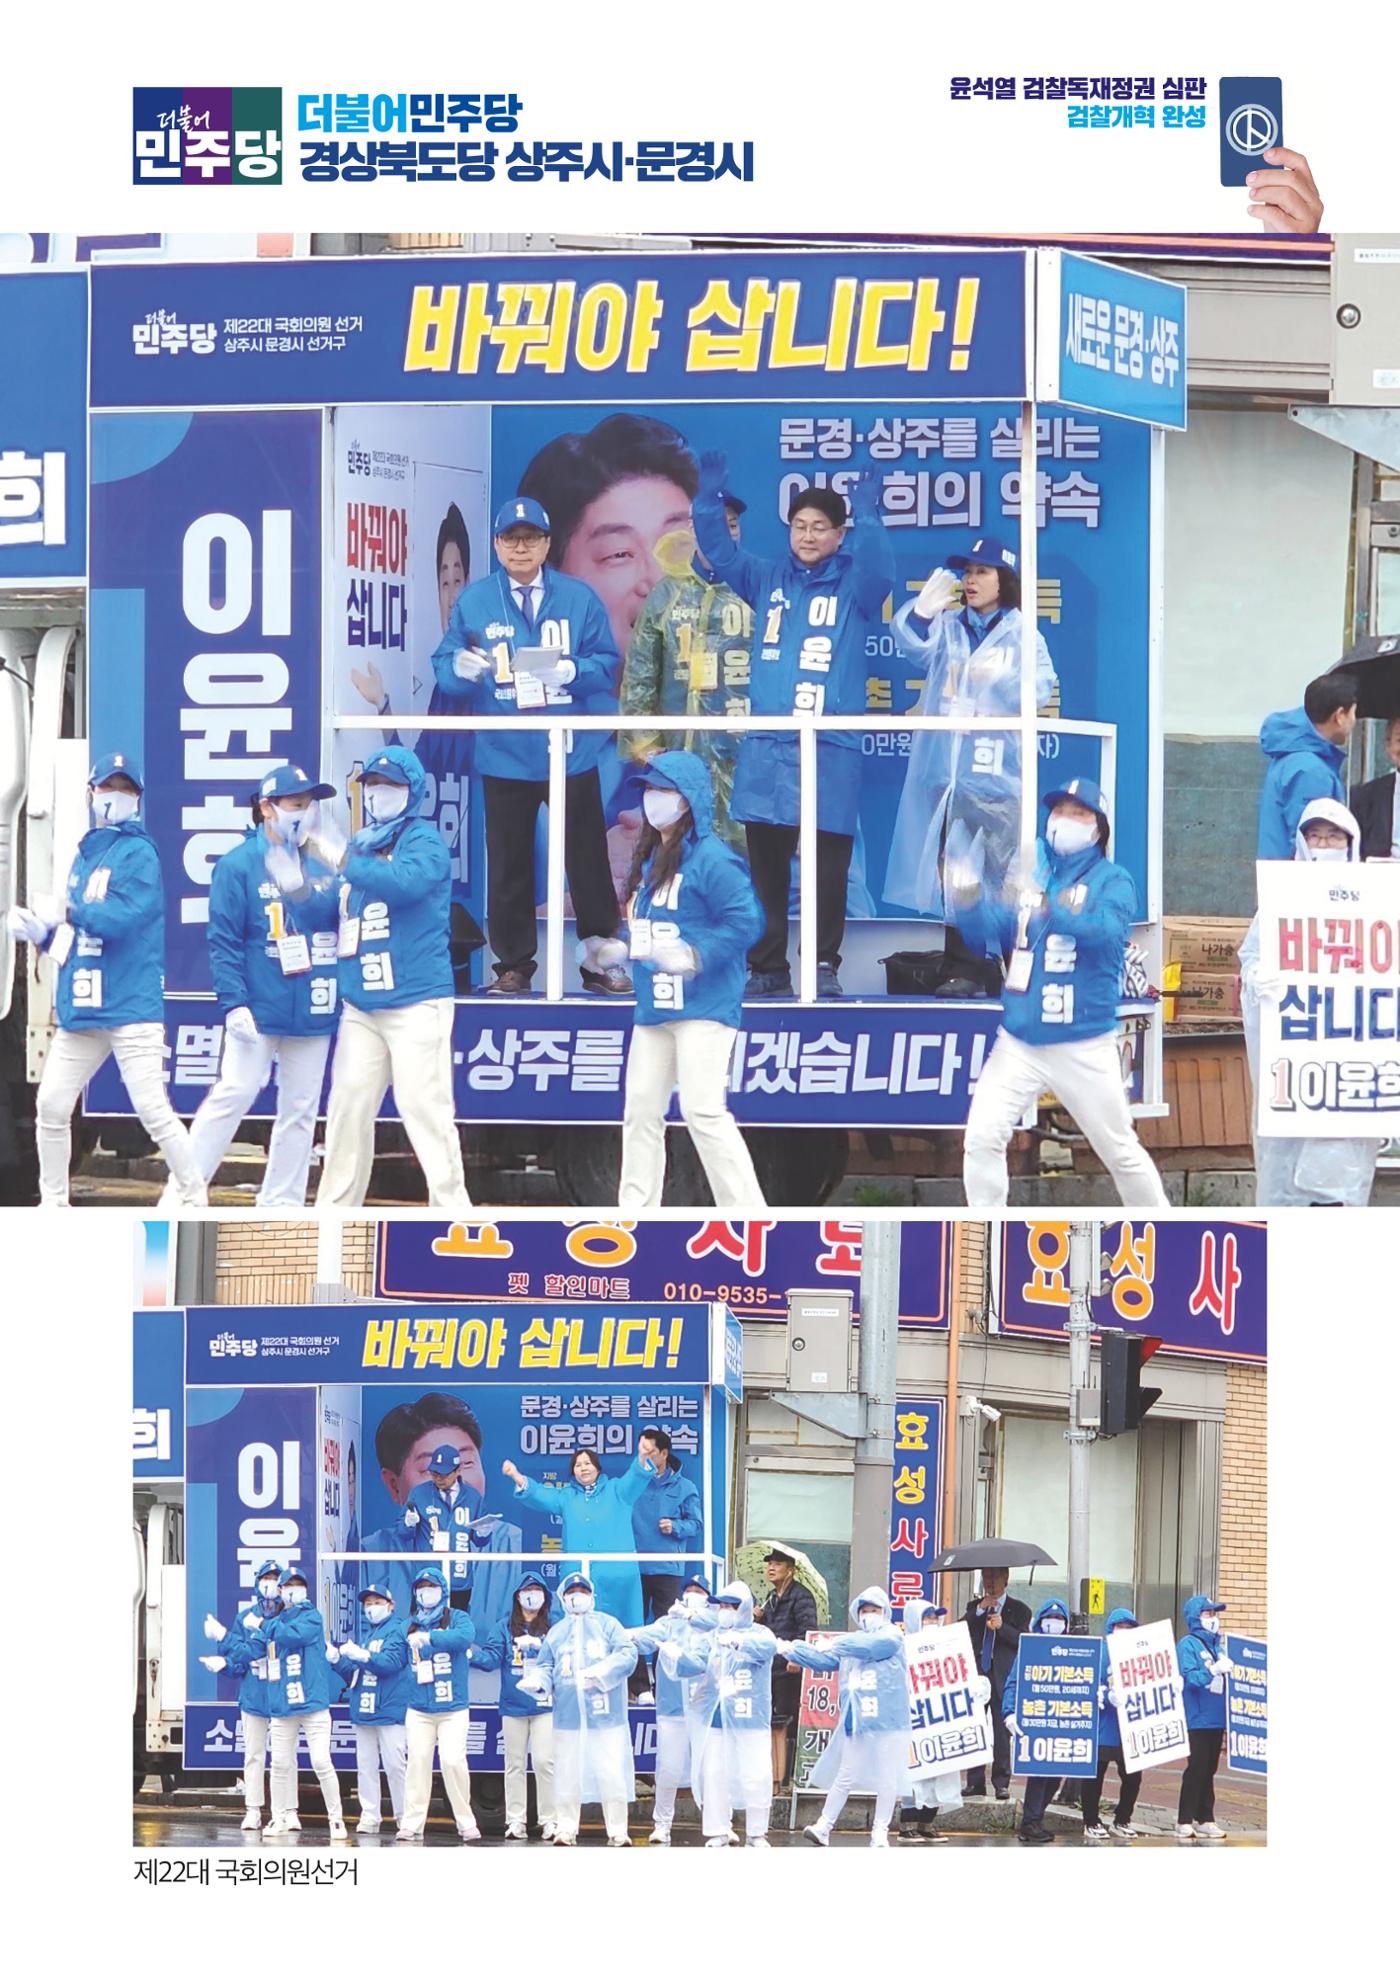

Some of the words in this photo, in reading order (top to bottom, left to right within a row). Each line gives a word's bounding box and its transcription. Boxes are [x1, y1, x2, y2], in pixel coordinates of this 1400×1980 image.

[132, 323, 218, 355] 민주당
[223, 317, 272, 334] 제22대
[274, 316, 332, 333] 국회의원
[334, 315, 363, 332] 선거
[223, 337, 263, 353] 상주시
[265, 336, 304, 352] 문경시
[306, 335, 346, 351] 선거구
[403, 279, 664, 374] 바꿔야
[685, 277, 981, 373] 삽니다!
[1065, 292, 1111, 372] 새로운
[1114, 304, 1180, 388] 문경·상주
[779, 418, 978, 460] 문경·상주를
[347, 502, 408, 576] 바꿔야
[347, 578, 408, 652] 삽니다
[763, 605, 783, 644] 1
[492, 642, 513, 683] 1
[676, 623, 692, 663] 1
[264, 902, 288, 940] 1
[360, 902, 395, 991] 윤희
[310, 931, 338, 1014] 윤희
[1270, 1057, 1297, 1112] 1
[507, 1272, 529, 1295] 펫
[543, 1274, 630, 1299] 할인마트
[209, 1339, 258, 1357] 민주당
[361, 1318, 508, 1369] 바꿔야
[518, 1317, 684, 1369] 삽니다!
[520, 1395, 631, 1419] 문경·상주를
[637, 1395, 699, 1419] 살리는
[520, 1424, 633, 1456] 이윤희의
[433, 1652, 453, 1702] 윤희
[1119, 1649, 1172, 1689] 바꿔야
[1124, 1683, 1176, 1723] 삽니다
[921, 1725, 989, 1764] 이윤희
[1018, 1736, 1031, 1762] 1
[1033, 1738, 1093, 1763] 이윤희
[1138, 1720, 1185, 1754] 이윤희
